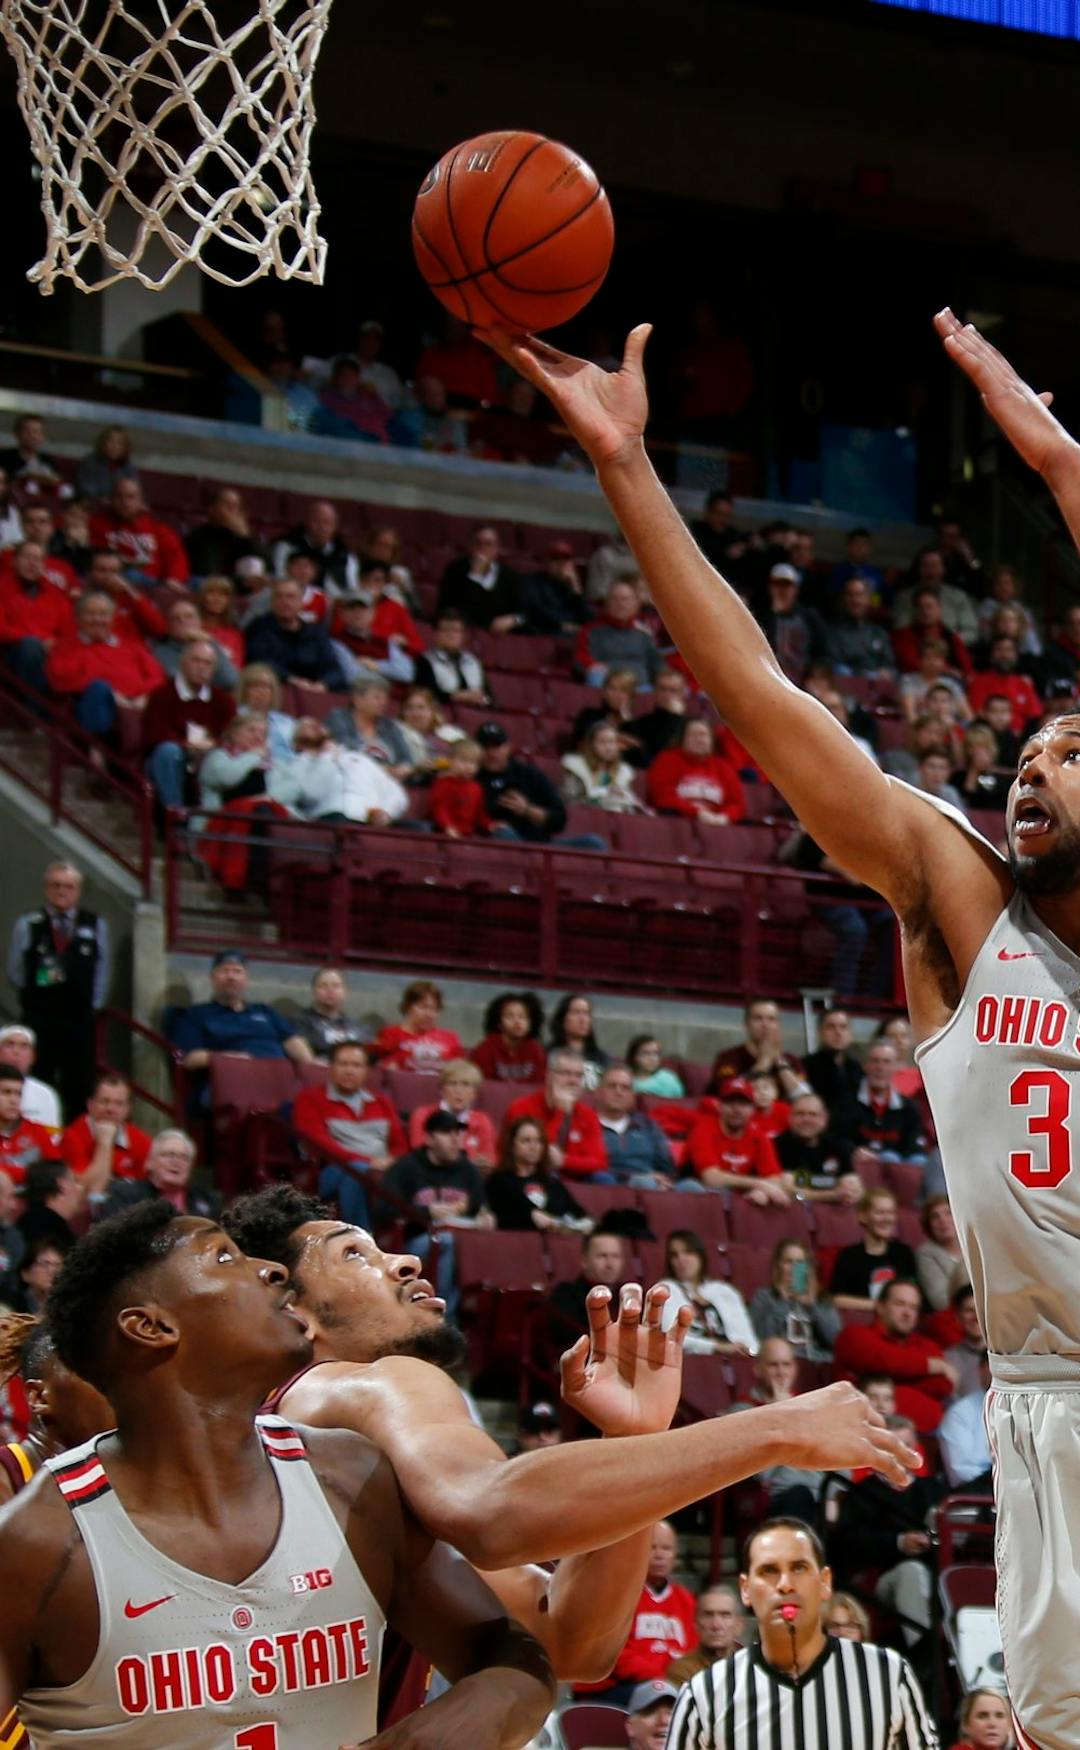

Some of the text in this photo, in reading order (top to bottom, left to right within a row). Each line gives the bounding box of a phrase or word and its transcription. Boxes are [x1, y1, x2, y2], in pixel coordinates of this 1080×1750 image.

[973, 993, 1070, 1049] OHIO
[115, 1615, 372, 1717] OHIO STATE
